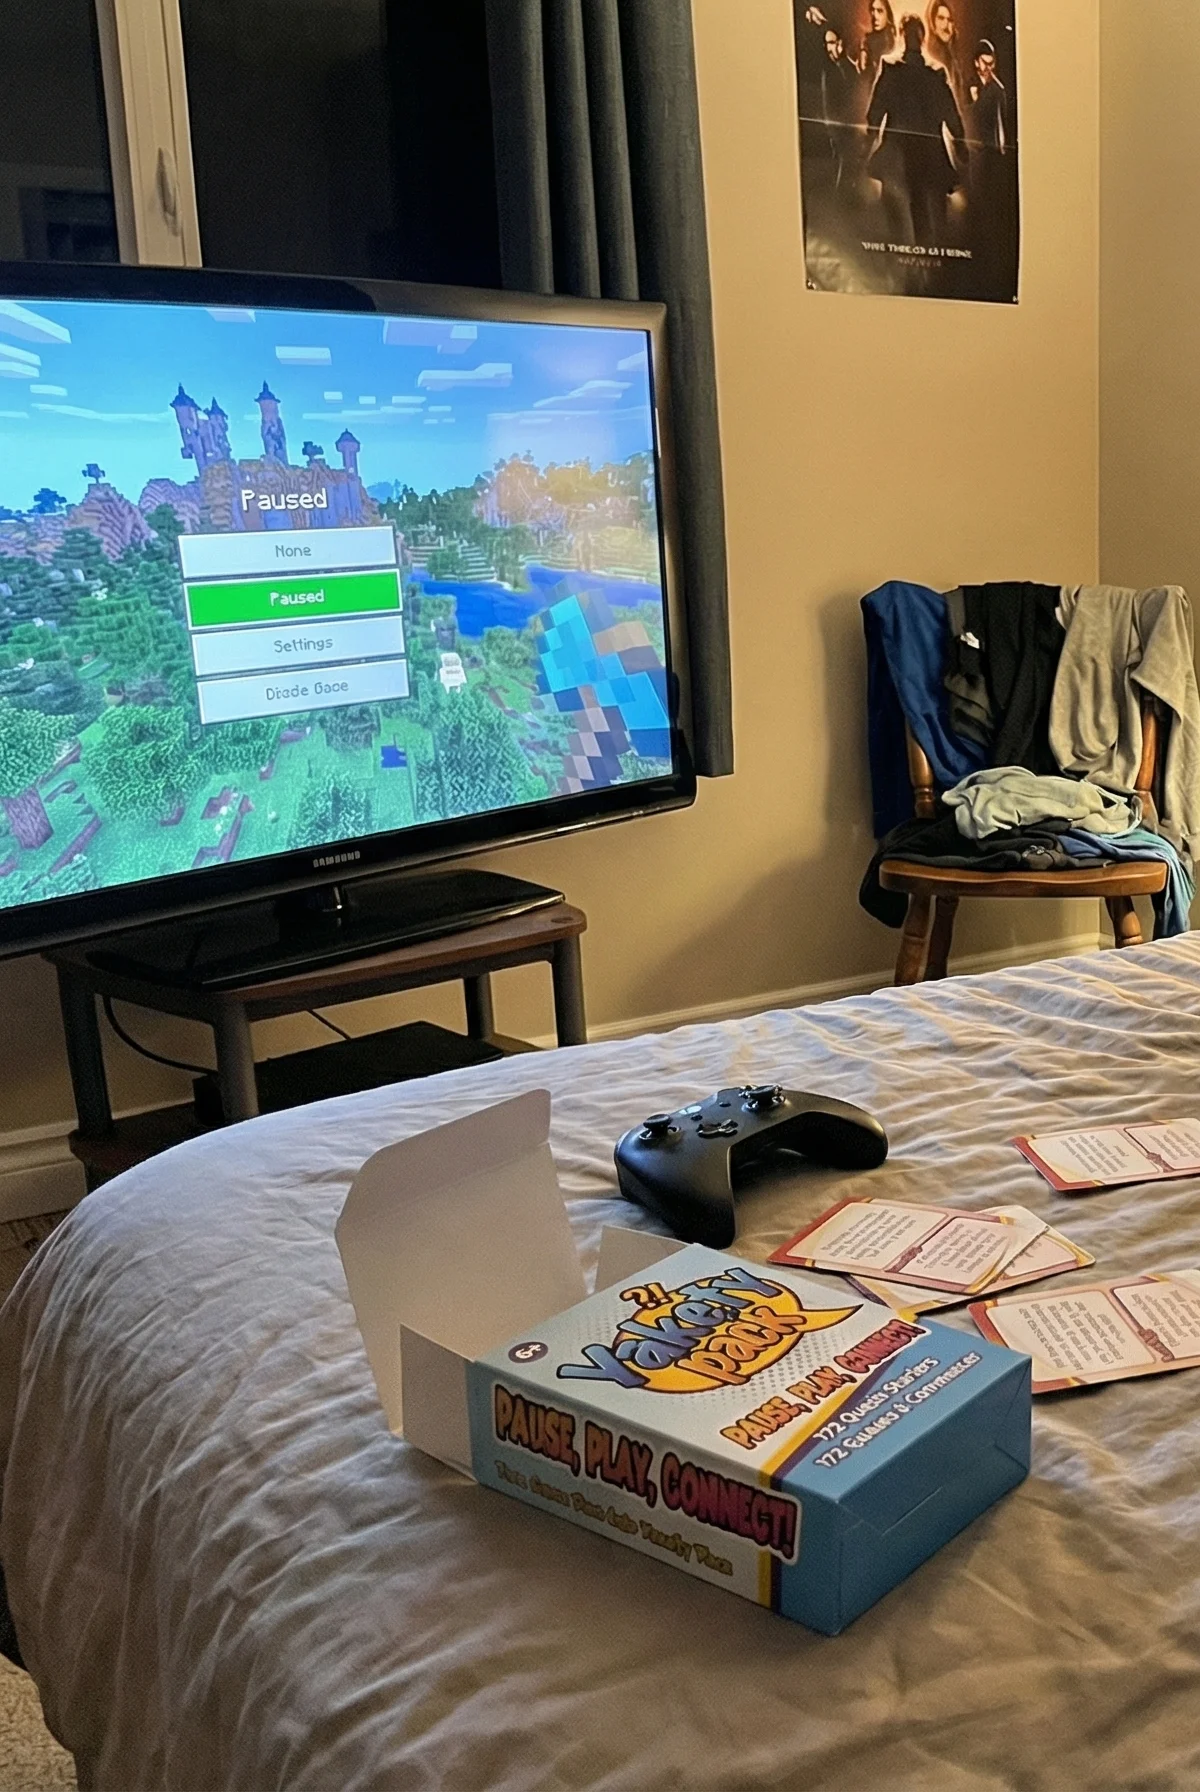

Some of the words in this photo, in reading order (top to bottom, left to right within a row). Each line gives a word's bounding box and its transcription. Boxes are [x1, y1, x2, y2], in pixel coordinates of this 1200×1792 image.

[241, 487, 328, 512] Paused
[275, 544, 312, 558] None
[270, 589, 325, 607] Paused
[273, 637, 333, 654] Settings
[556, 1267, 783, 1388] Yakety
[674, 1305, 807, 1385] pack
[719, 1396, 813, 1450] PAUSE,
[785, 1365, 858, 1405] PLAY,
[494, 1384, 580, 1477] PAUSE,
[584, 1420, 658, 1508] PLAY,
[660, 1451, 798, 1559] CONNECT!
